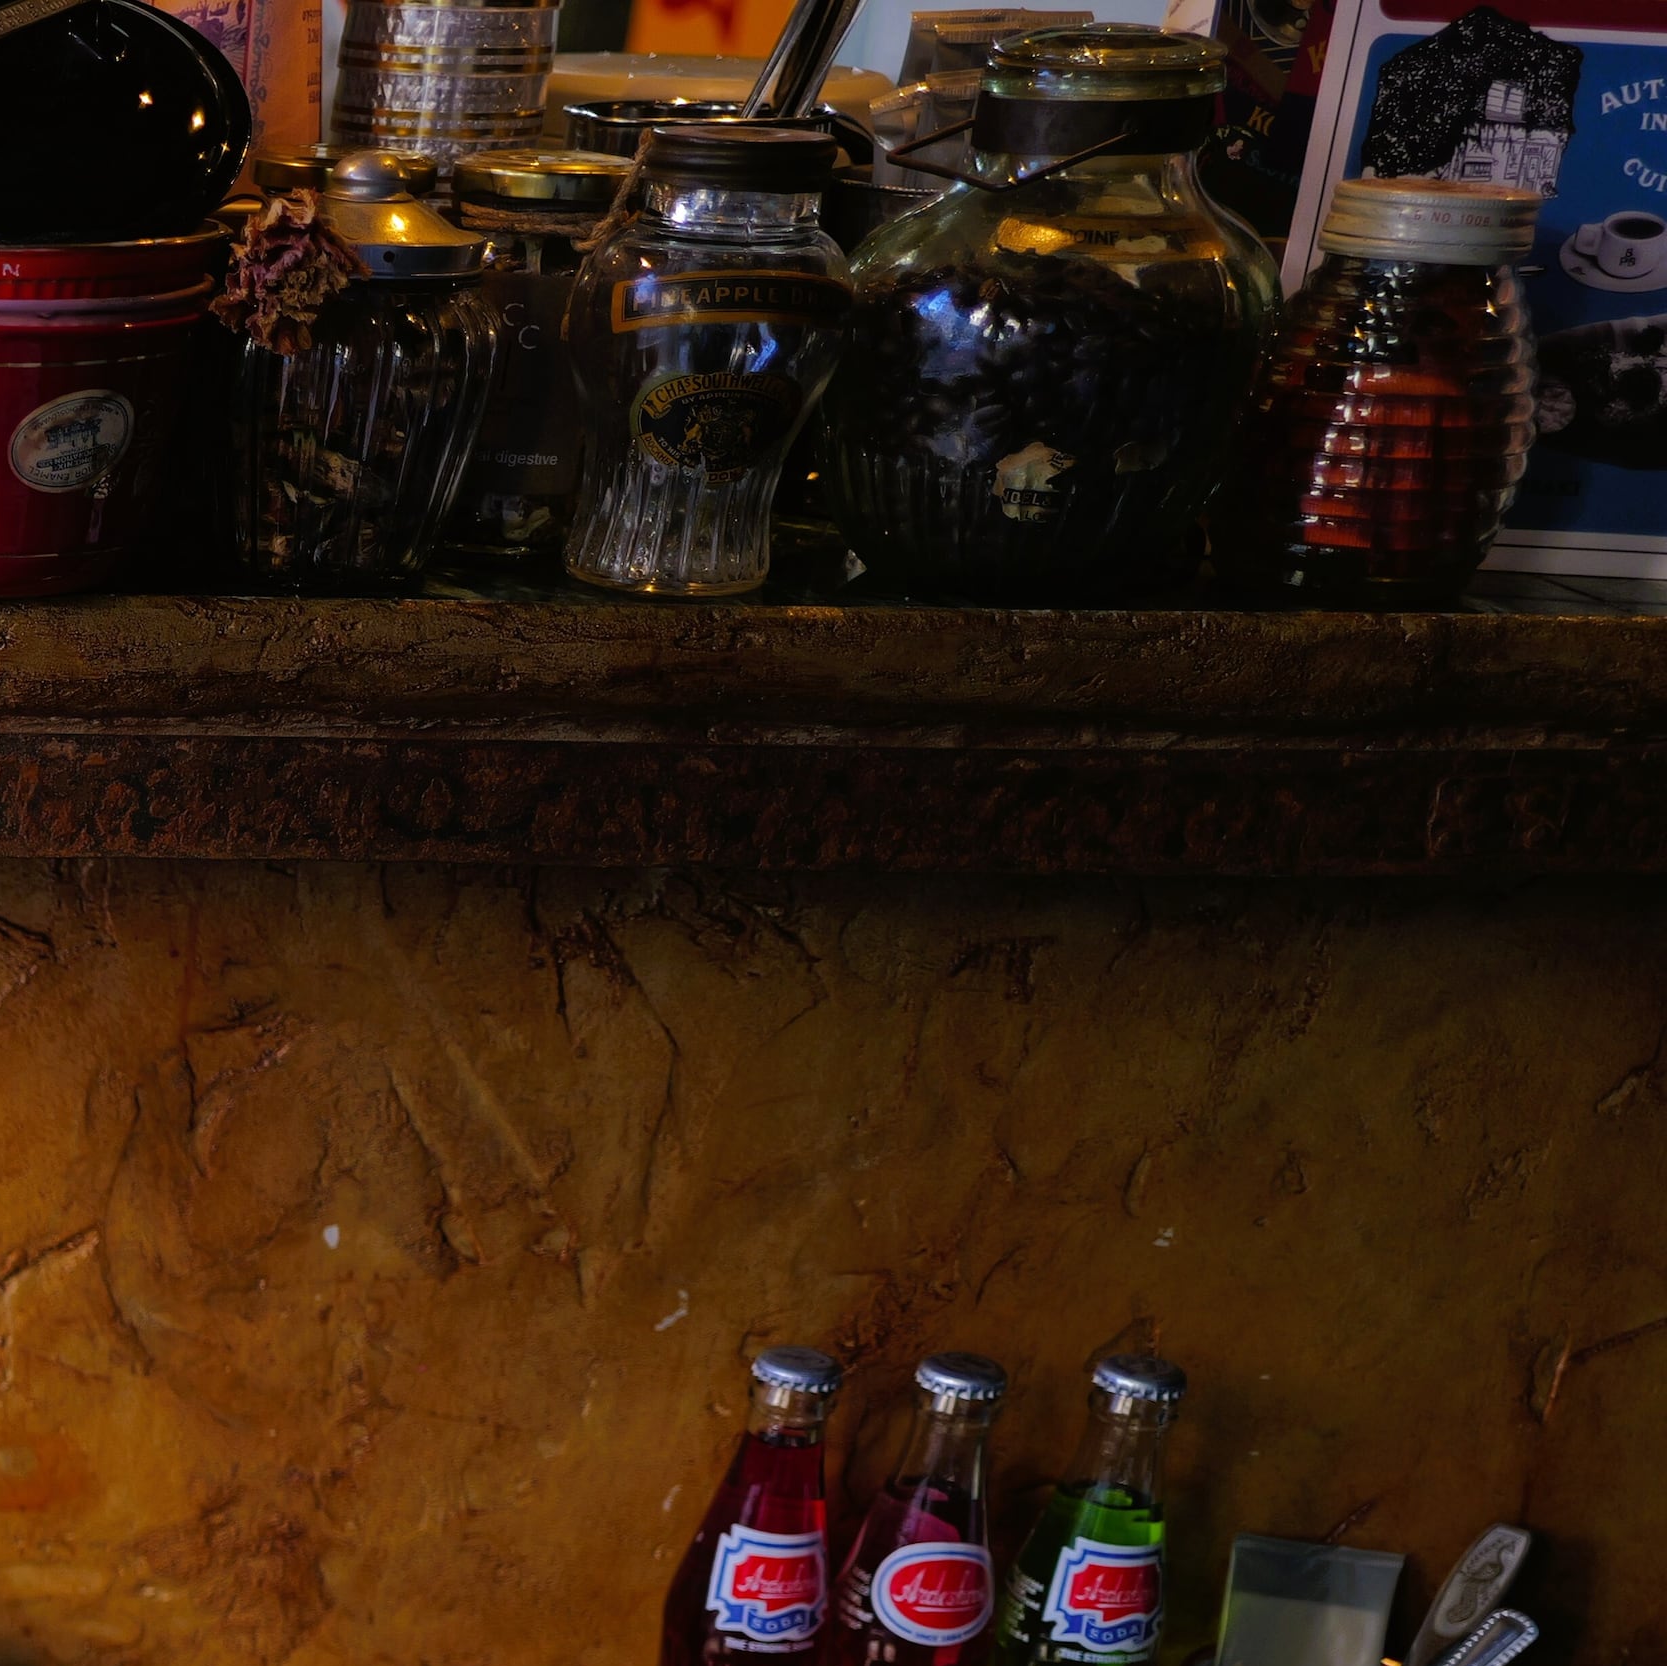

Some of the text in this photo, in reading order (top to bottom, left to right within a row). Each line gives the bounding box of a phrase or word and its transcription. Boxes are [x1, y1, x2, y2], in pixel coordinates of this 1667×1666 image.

[1601, 79, 1667, 115] AUT
[1640, 112, 1667, 132] IN
[1623, 157, 1667, 192] CUI
[632, 286, 779, 312] PINEAPPLE
[495, 450, 559, 467] digestive
[752, 1613, 805, 1633] SODA
[1089, 1625, 1140, 1641] SODA
